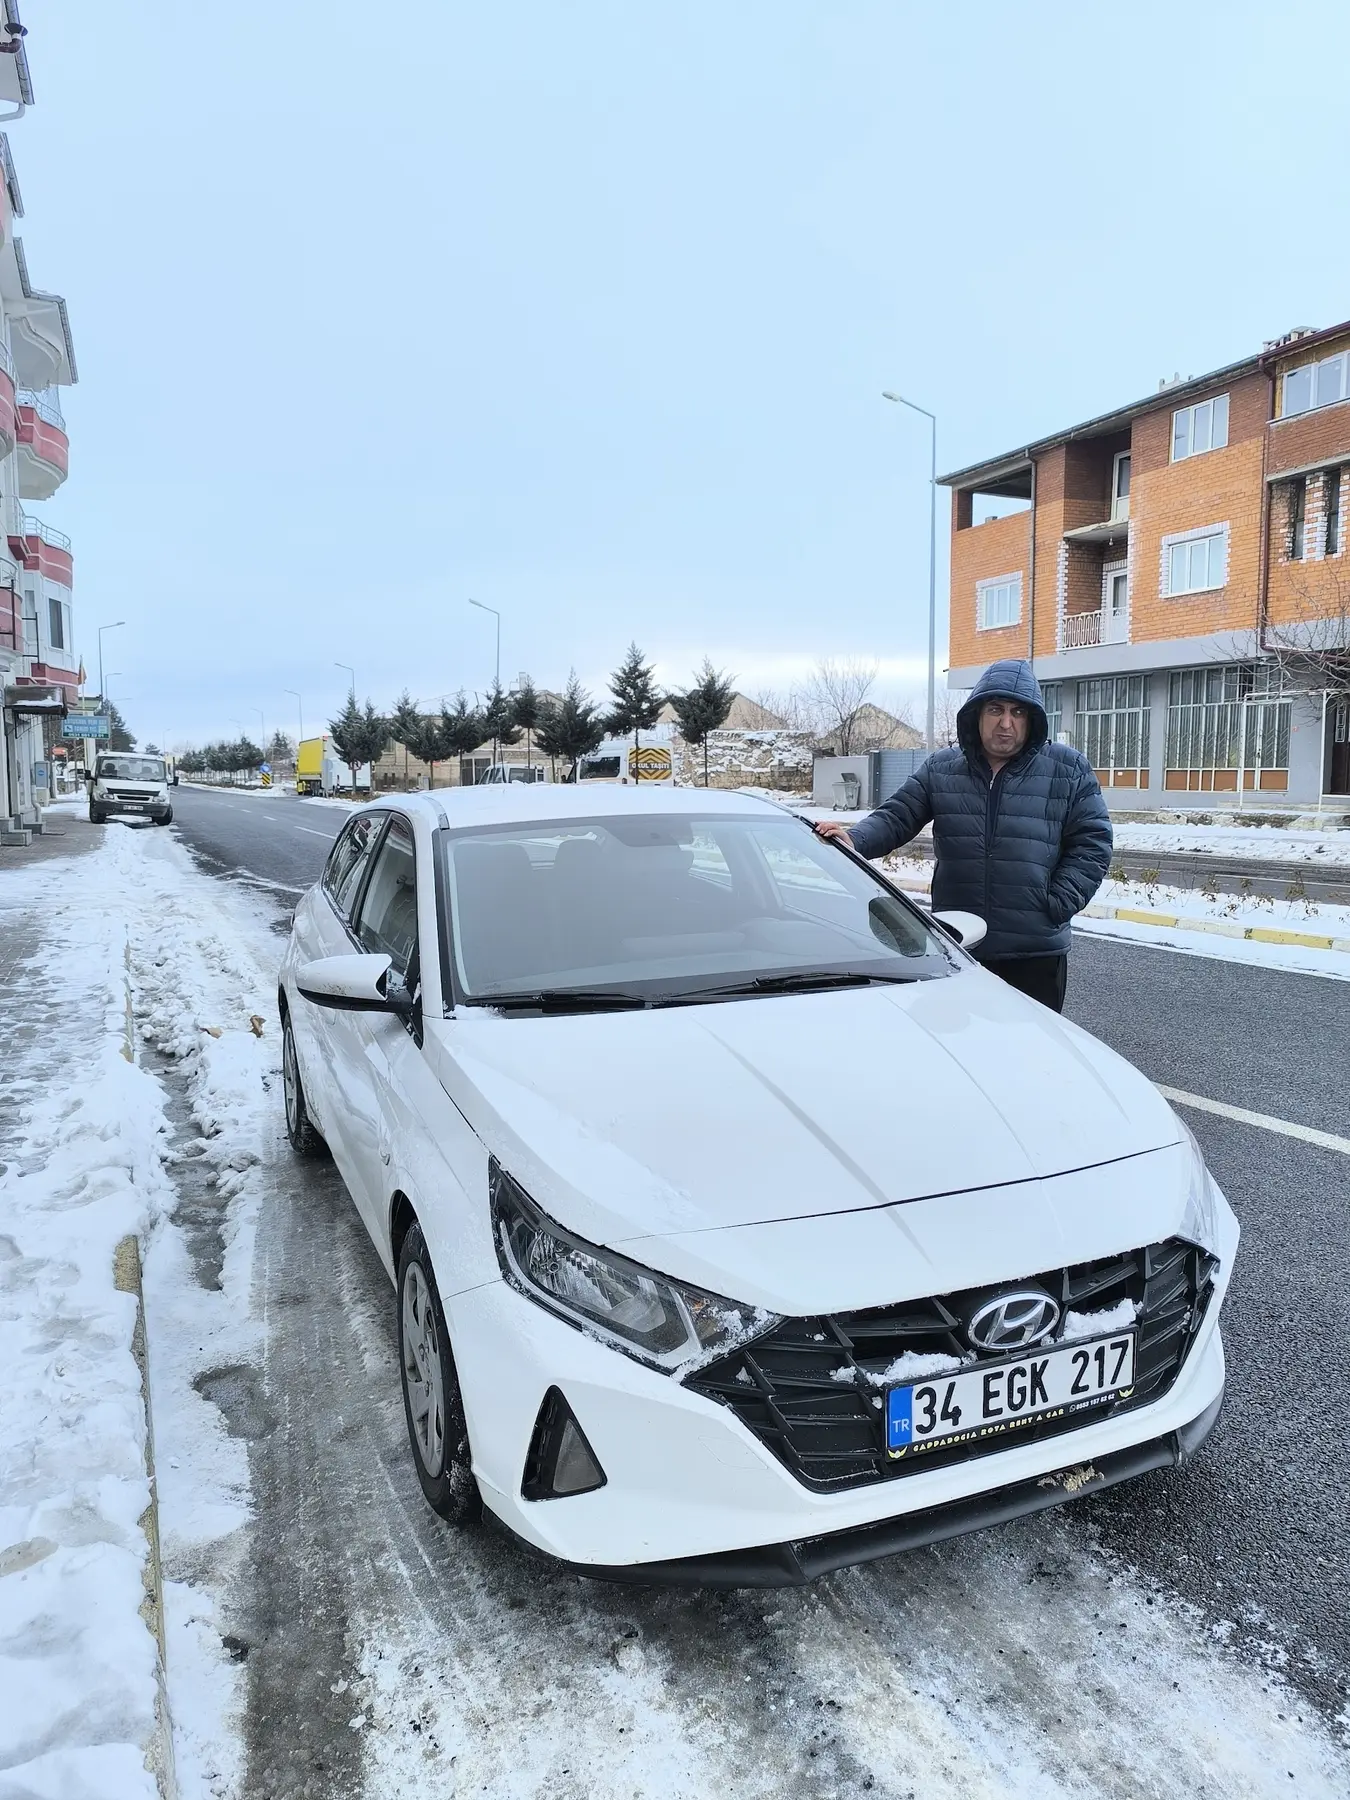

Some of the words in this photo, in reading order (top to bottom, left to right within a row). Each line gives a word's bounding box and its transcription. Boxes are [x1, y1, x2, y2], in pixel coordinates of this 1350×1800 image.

[915, 1381, 962, 1434] 34
[982, 1359, 1049, 1419] EGK
[1070, 1339, 1130, 1396] 217
[892, 1418, 910, 1433] TR
[913, 1431, 977, 1452] CAPPADOCIA
[981, 1424, 1006, 1435] ROTA
[1009, 1416, 1033, 1429] RENT
[1036, 1414, 1043, 1422] A
[1046, 1408, 1064, 1419] CAR
